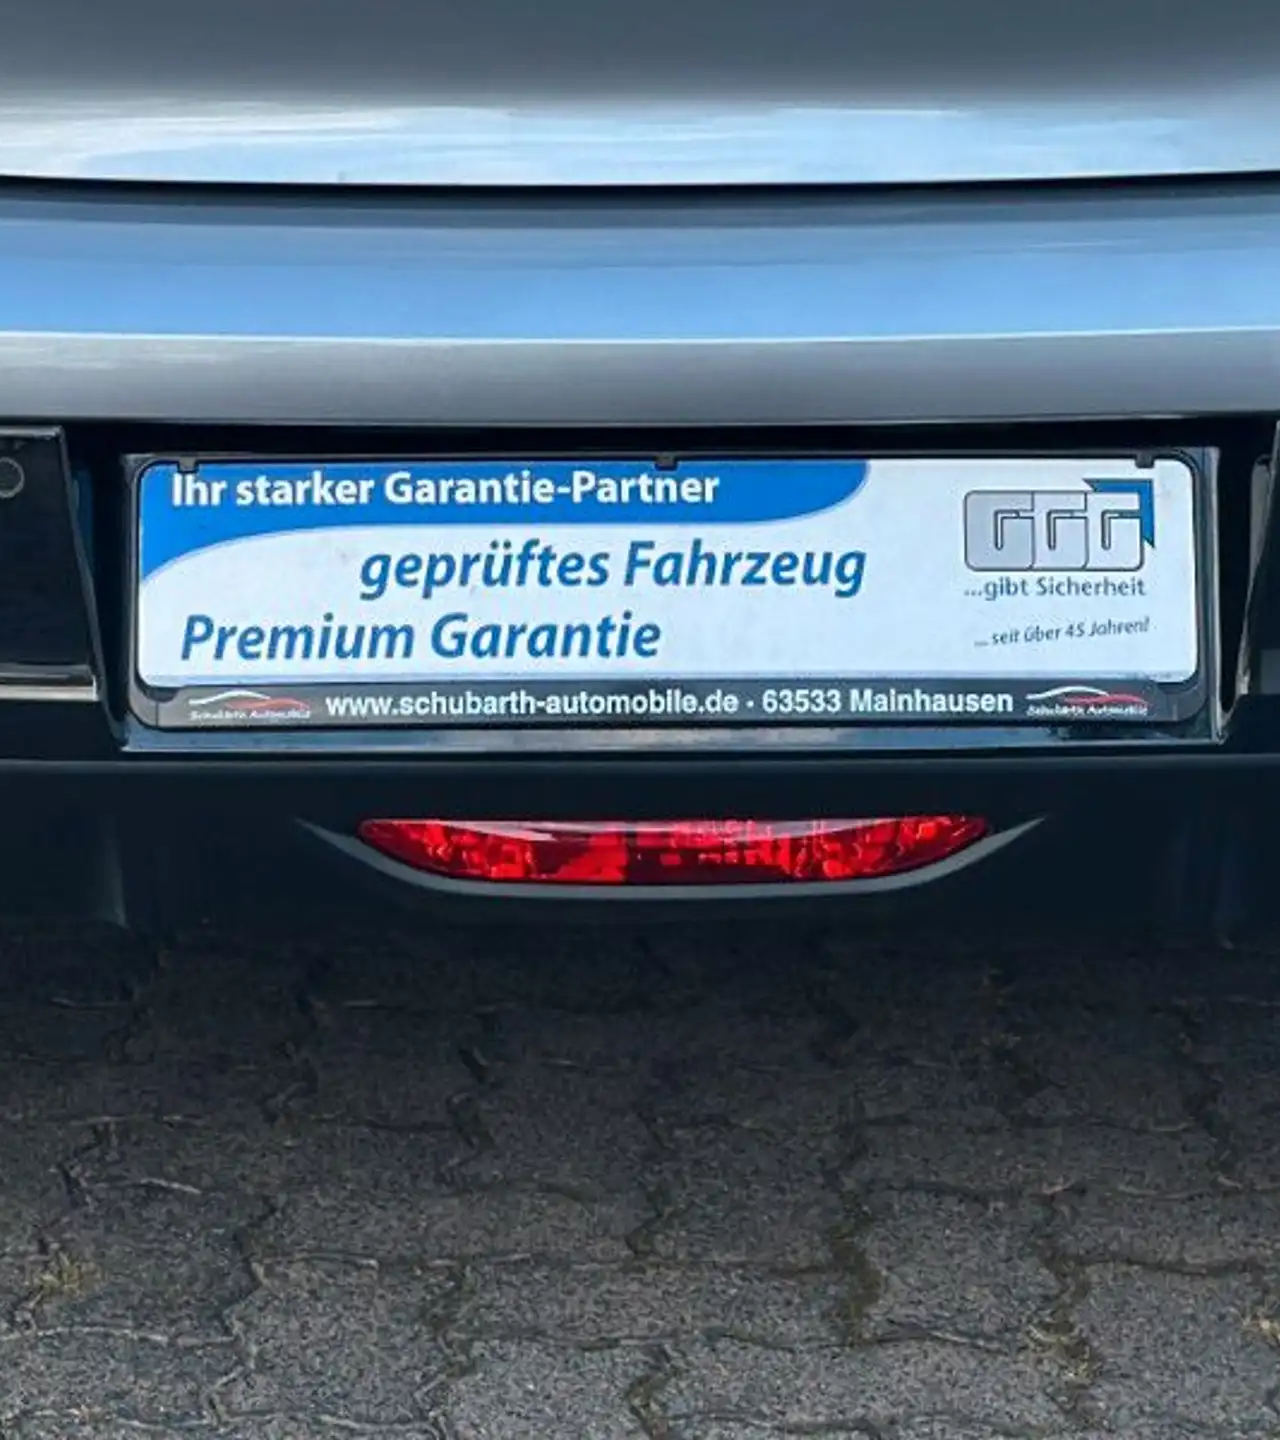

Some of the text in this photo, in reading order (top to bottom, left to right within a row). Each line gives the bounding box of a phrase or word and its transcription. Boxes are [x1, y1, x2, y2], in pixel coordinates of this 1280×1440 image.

[172, 469, 720, 507] Ihr starker Garantie-Partner
[359, 538, 867, 601] geprüftes Fahrzeug
[1036, 575, 1147, 597] Sicherheit
[180, 610, 662, 661] Premium Garantie
[1065, 621, 1086, 639] 45
[326, 689, 739, 717] www.schubarth-automobile.de
[762, 688, 842, 713] 63533
[850, 687, 1014, 713] Mainhausen
